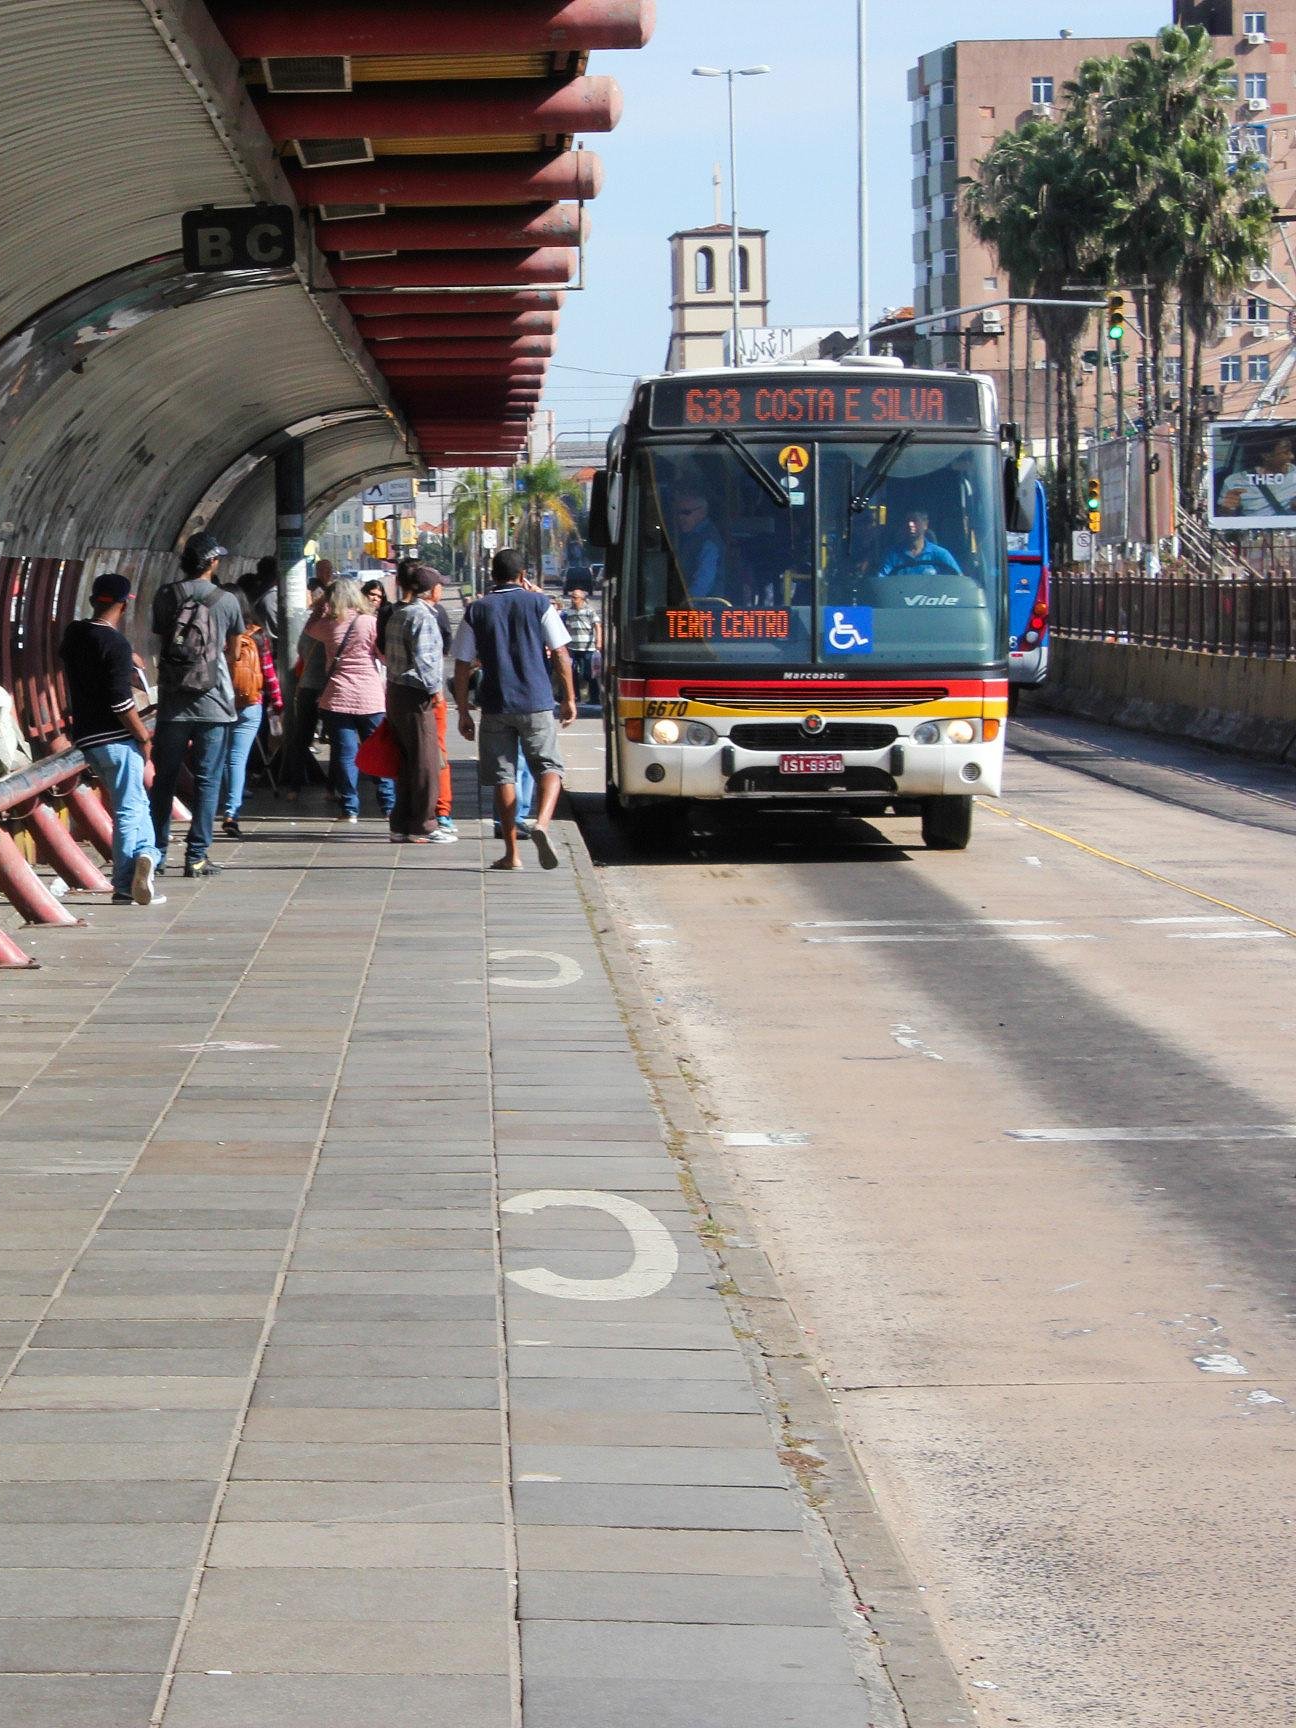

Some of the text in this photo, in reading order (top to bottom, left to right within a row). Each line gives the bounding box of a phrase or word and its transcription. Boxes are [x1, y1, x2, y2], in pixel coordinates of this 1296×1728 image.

[197, 223, 284, 266] B C
[685, 387, 944, 424] 633 COSTA E SILVA
[786, 447, 803, 468] A
[1246, 473, 1284, 486] THEO
[903, 594, 960, 606] Viale
[720, 610, 789, 638] CENTRO
[783, 671, 846, 681] Marcopolo
[646, 700, 689, 717] 6670
